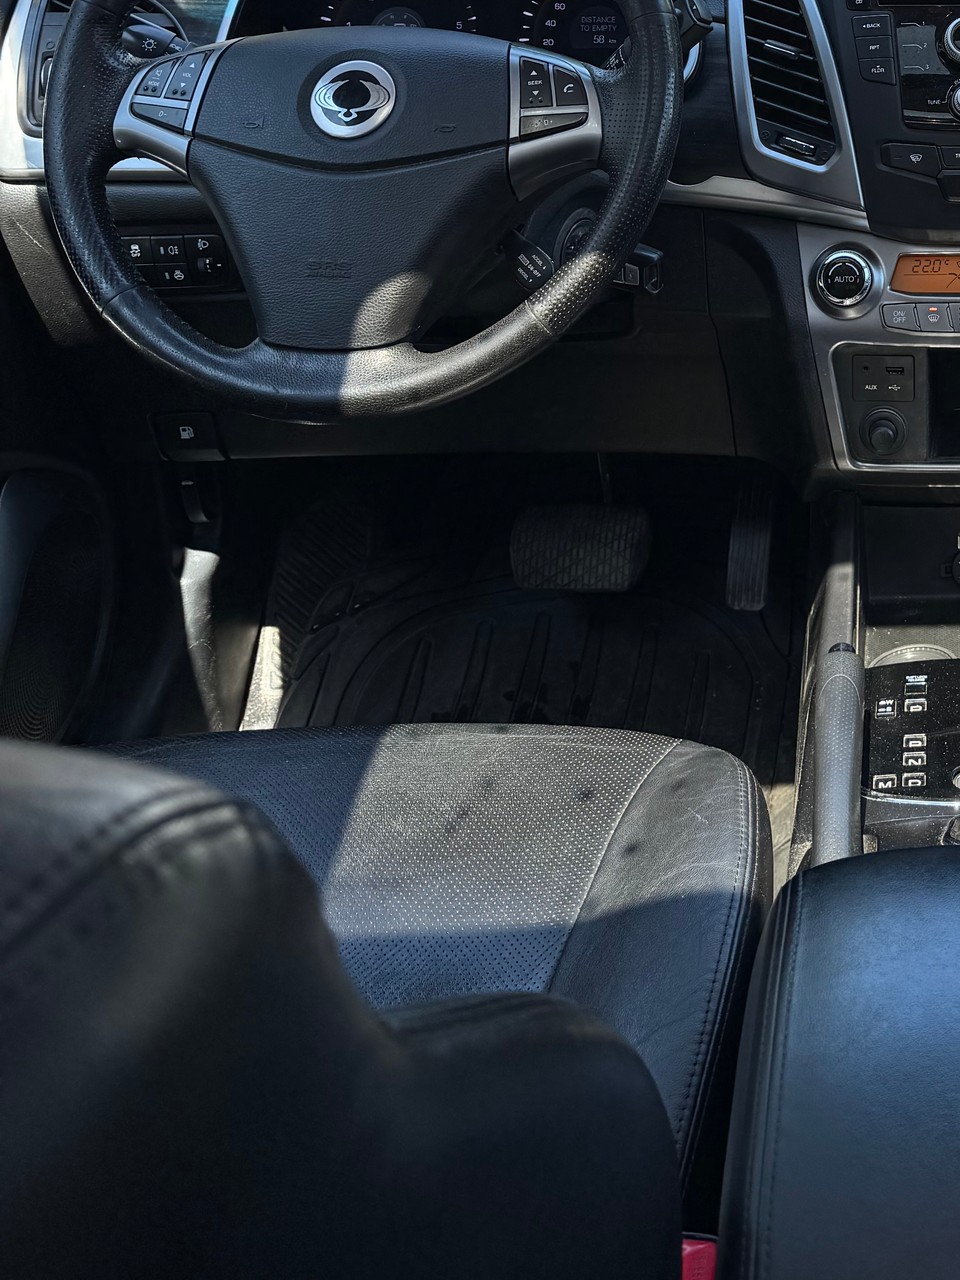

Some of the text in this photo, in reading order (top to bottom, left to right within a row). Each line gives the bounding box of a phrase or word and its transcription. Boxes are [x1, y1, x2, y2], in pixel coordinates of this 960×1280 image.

[554, 2, 566, 10] 60
[456, 21, 463, 29] 5
[545, 19, 556, 27] 40
[542, 38, 554, 46] 20
[593, 35, 605, 44] 58
[834, 275, 855, 283] AUTO
[908, 758, 922, 766] N
[878, 780, 892, 789] M
